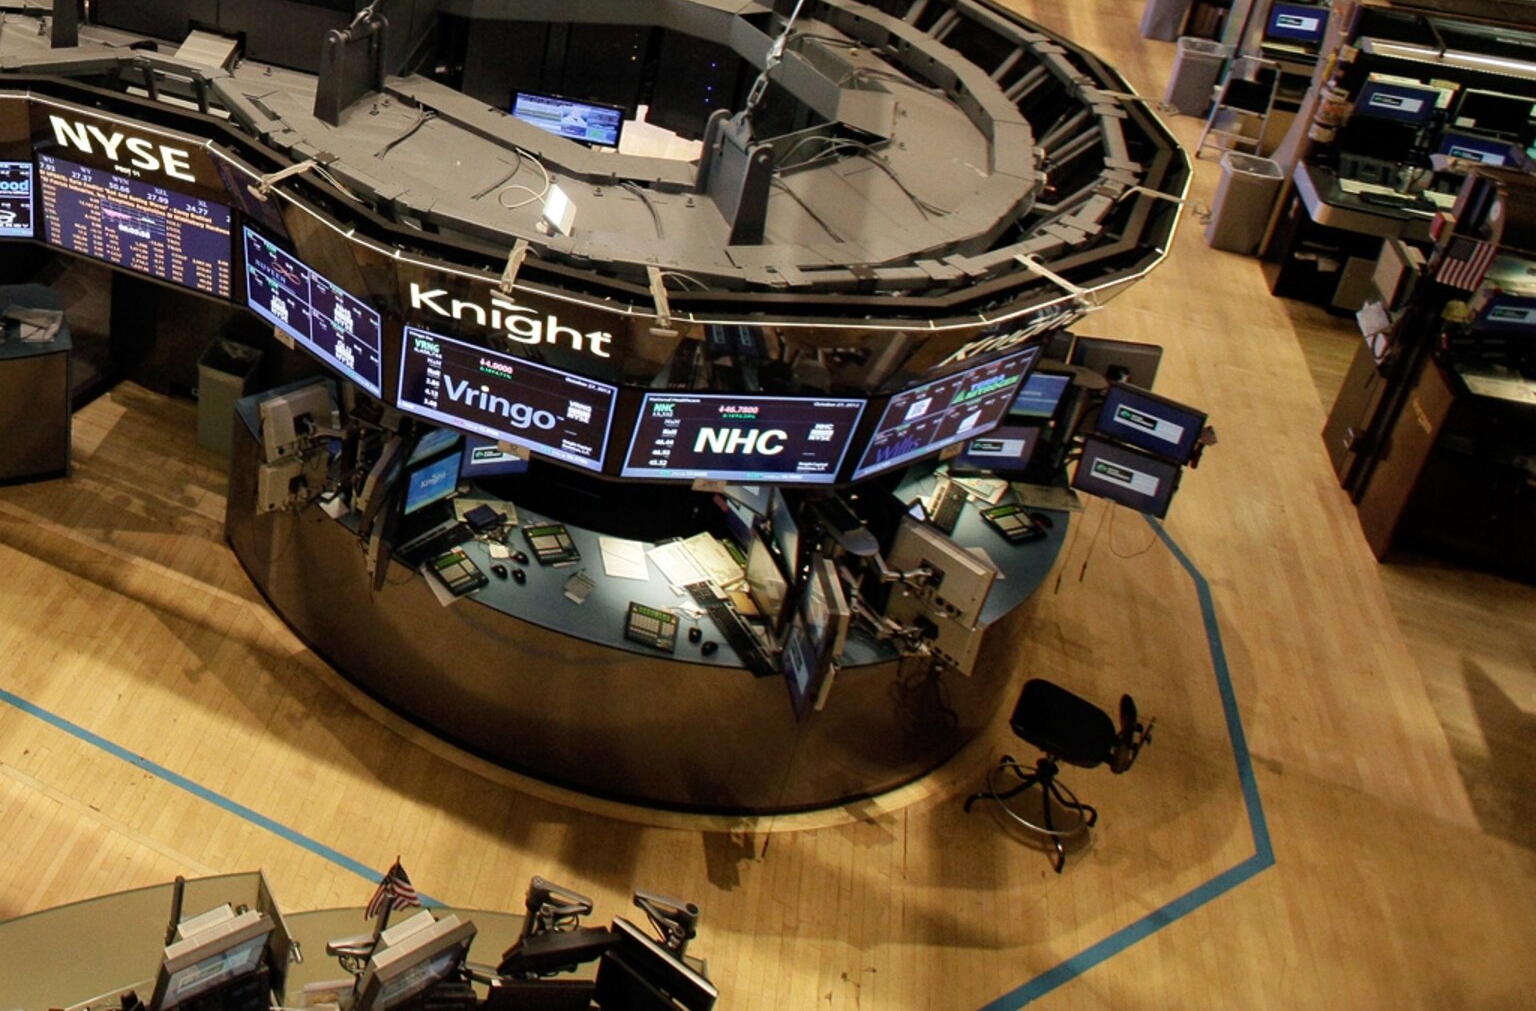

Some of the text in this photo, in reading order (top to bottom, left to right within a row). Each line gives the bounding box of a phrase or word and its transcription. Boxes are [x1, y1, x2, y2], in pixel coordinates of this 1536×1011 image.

[48, 115, 197, 183] NYSE
[410, 282, 613, 359] Knight
[413, 337, 440, 354] VRNG
[444, 373, 557, 430] Vringo
[653, 403, 675, 413] NHC
[693, 426, 788, 456] NHC
